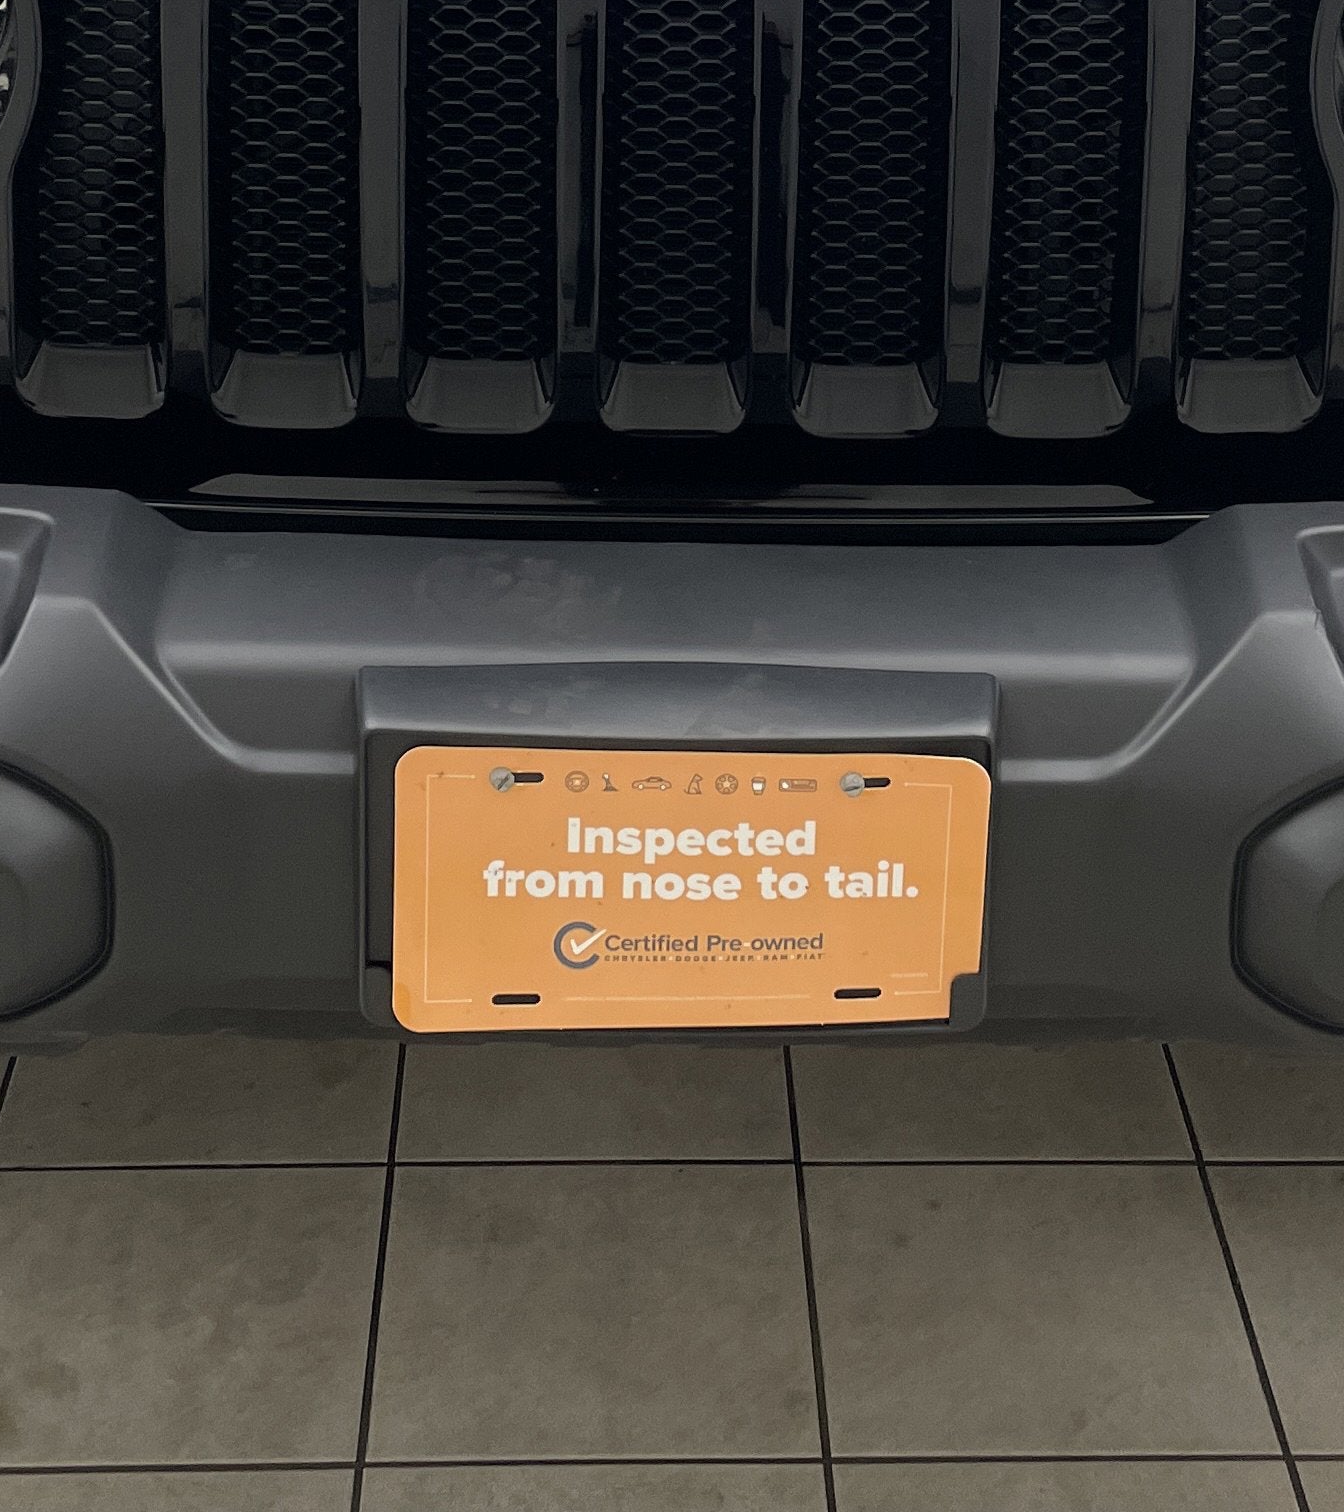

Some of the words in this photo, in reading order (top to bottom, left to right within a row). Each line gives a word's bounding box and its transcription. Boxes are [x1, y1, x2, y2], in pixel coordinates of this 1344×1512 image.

[567, 817, 816, 864] Inspected
[483, 860, 604, 898] from
[622, 872, 742, 900] nose
[756, 866, 809, 900] to
[824, 860, 919, 898] tail.
[605, 934, 698, 952] Certified
[707, 933, 824, 952] Pre-owned
